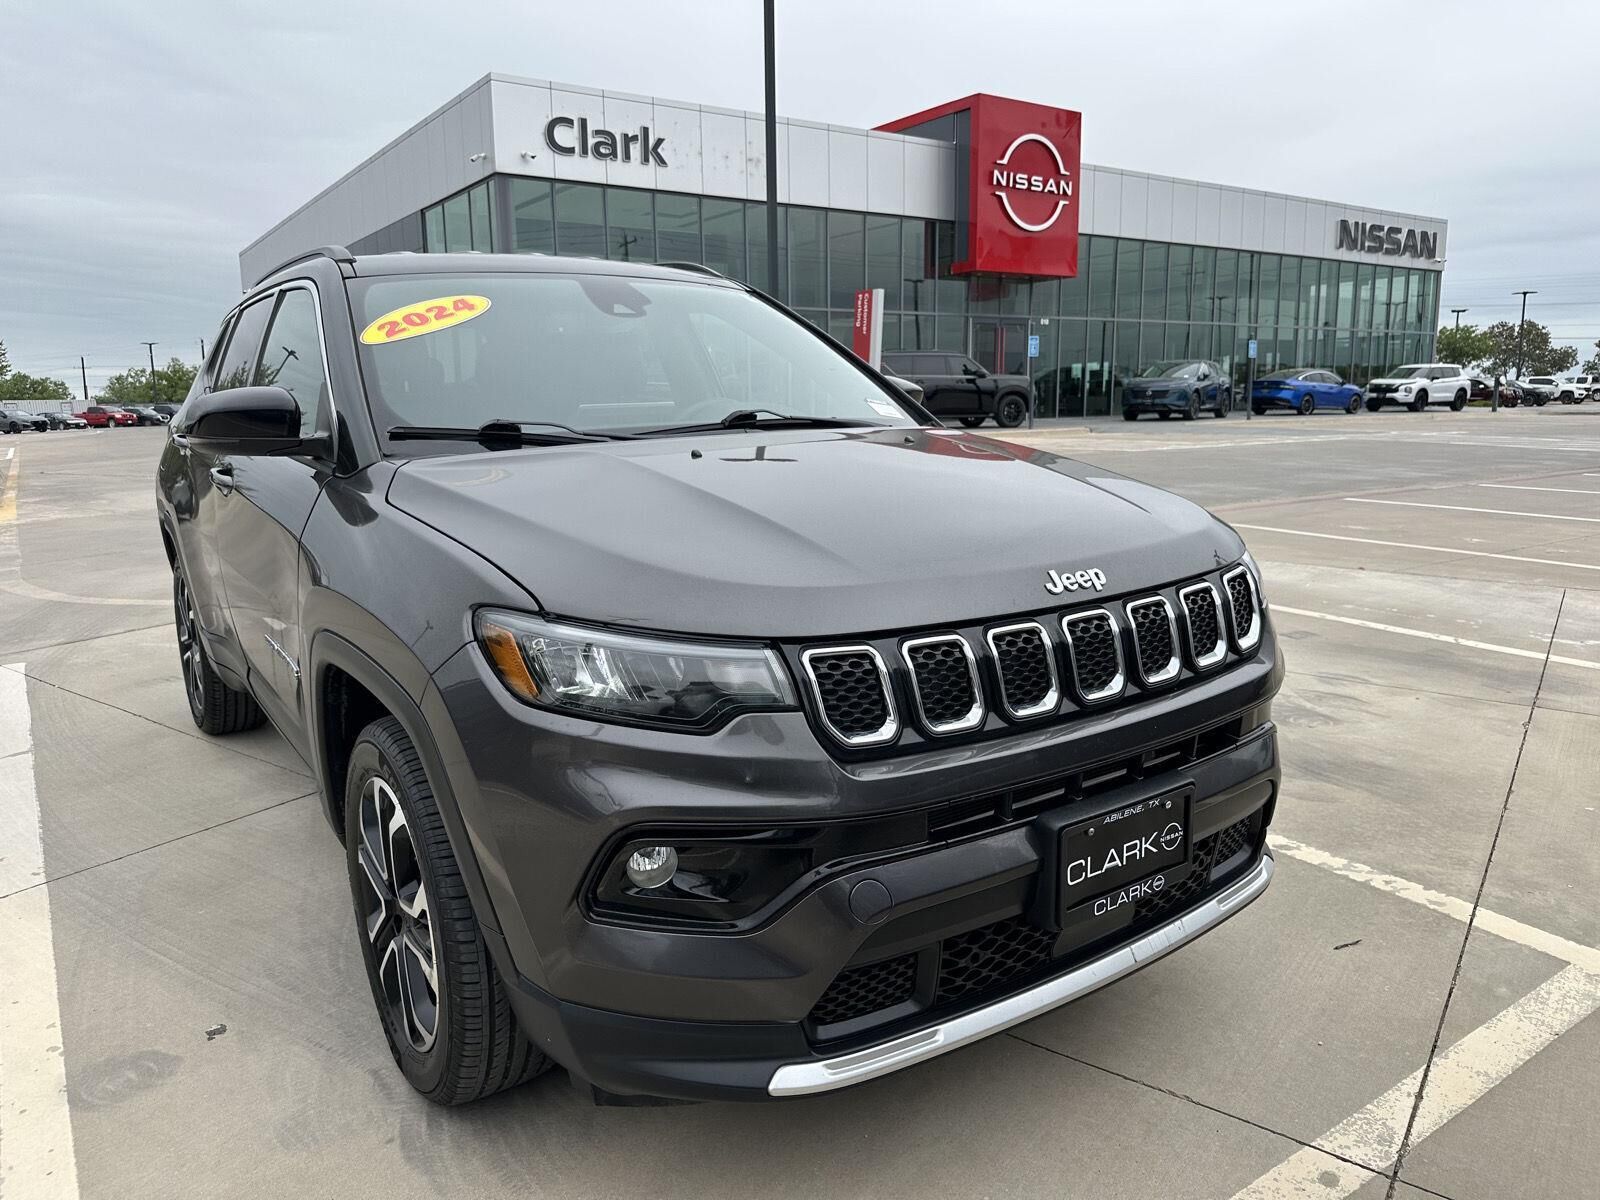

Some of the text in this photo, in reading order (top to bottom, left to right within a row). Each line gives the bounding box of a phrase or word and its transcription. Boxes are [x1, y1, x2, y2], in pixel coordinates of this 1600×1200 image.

[545, 116, 668, 168] Clark
[993, 169, 1072, 196] NISSAN
[1336, 219, 1437, 259] NISSAN
[377, 298, 475, 339] 2024
[1044, 567, 1107, 595] Jeep
[1148, 798, 1161, 808] TX
[1066, 830, 1184, 887] CLARK NISSAN
[1093, 879, 1152, 916] CLARK
